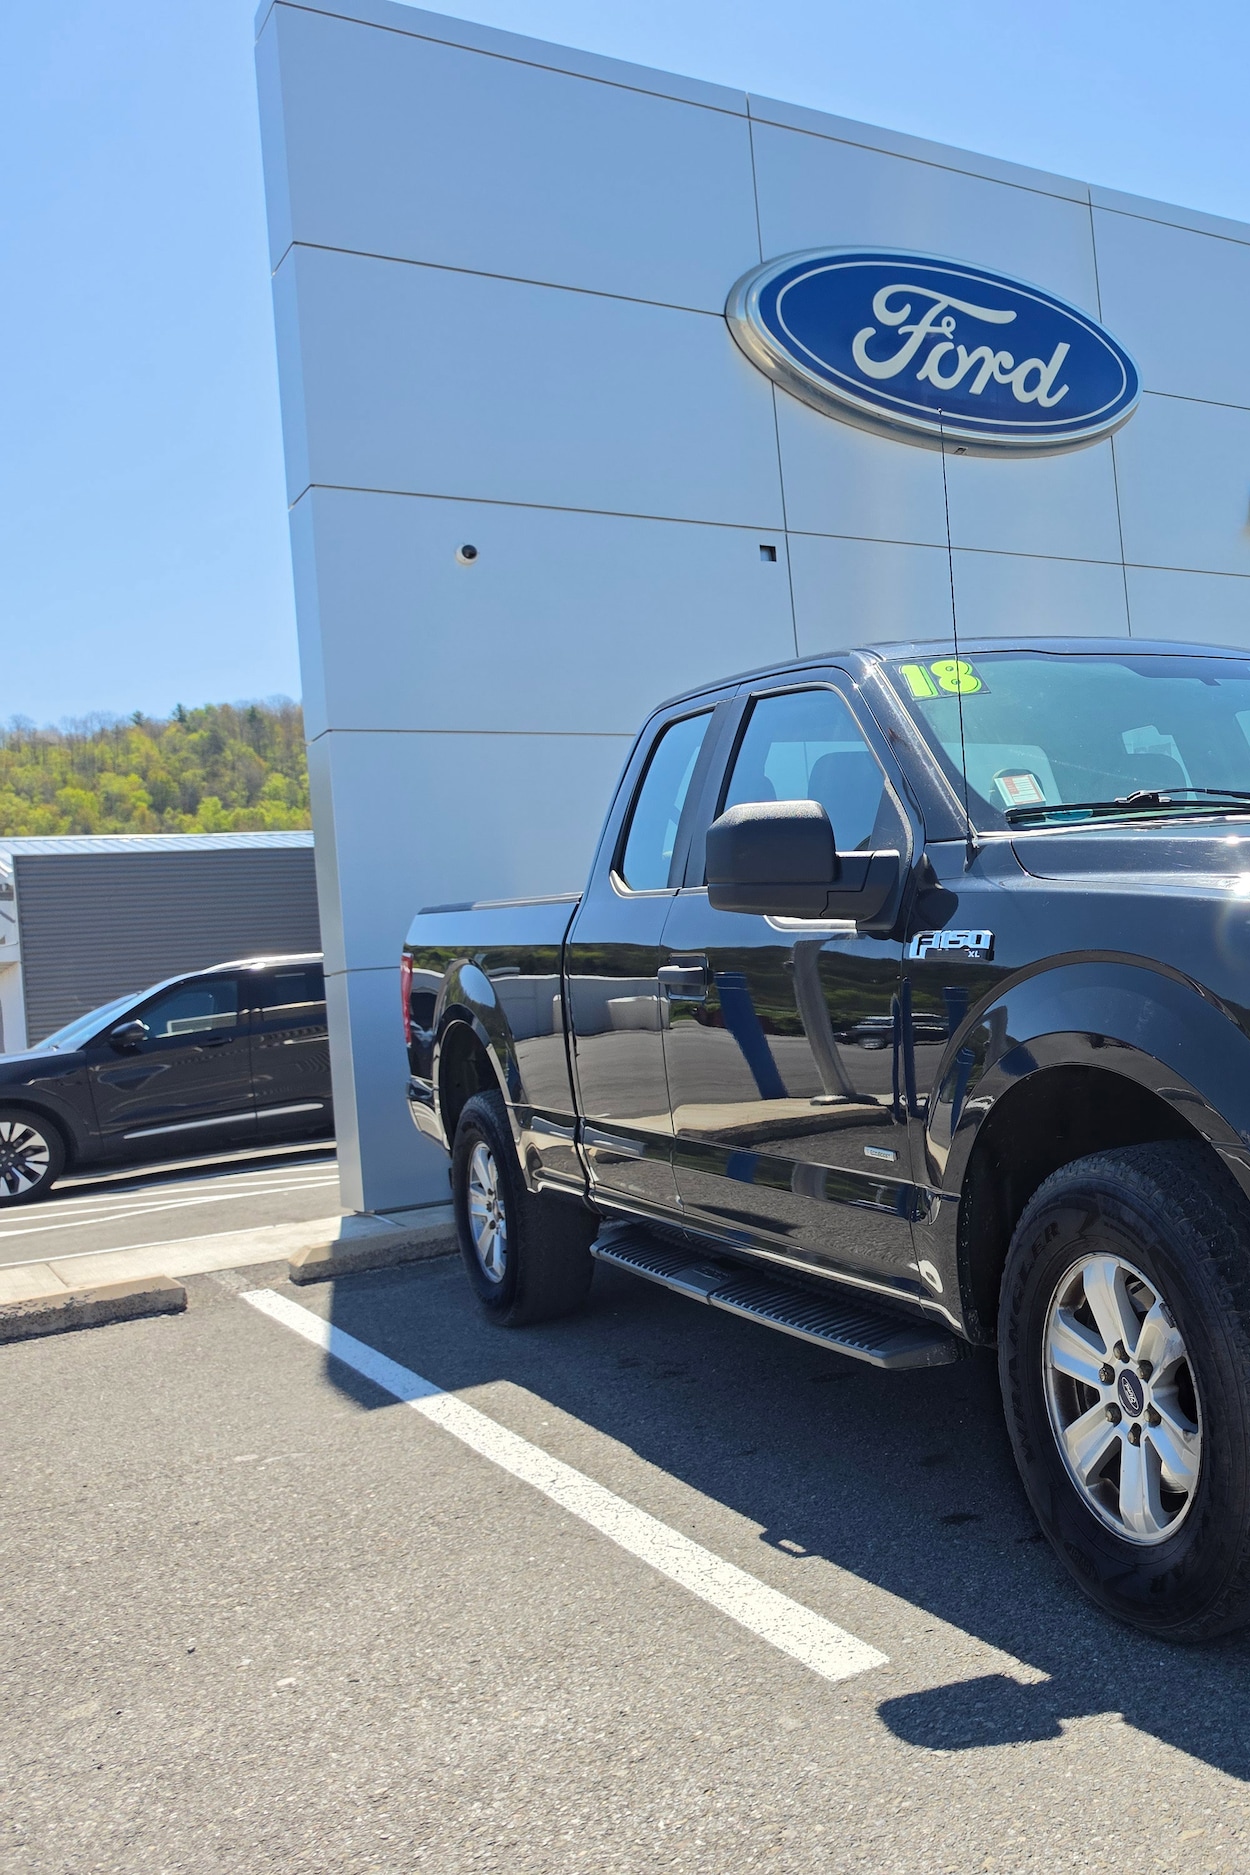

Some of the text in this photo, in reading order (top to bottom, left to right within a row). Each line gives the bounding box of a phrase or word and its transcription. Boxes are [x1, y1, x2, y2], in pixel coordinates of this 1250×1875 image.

[852, 283, 1071, 408] Ford
[899, 659, 982, 697] 18
[967, 950, 980, 958] XL
